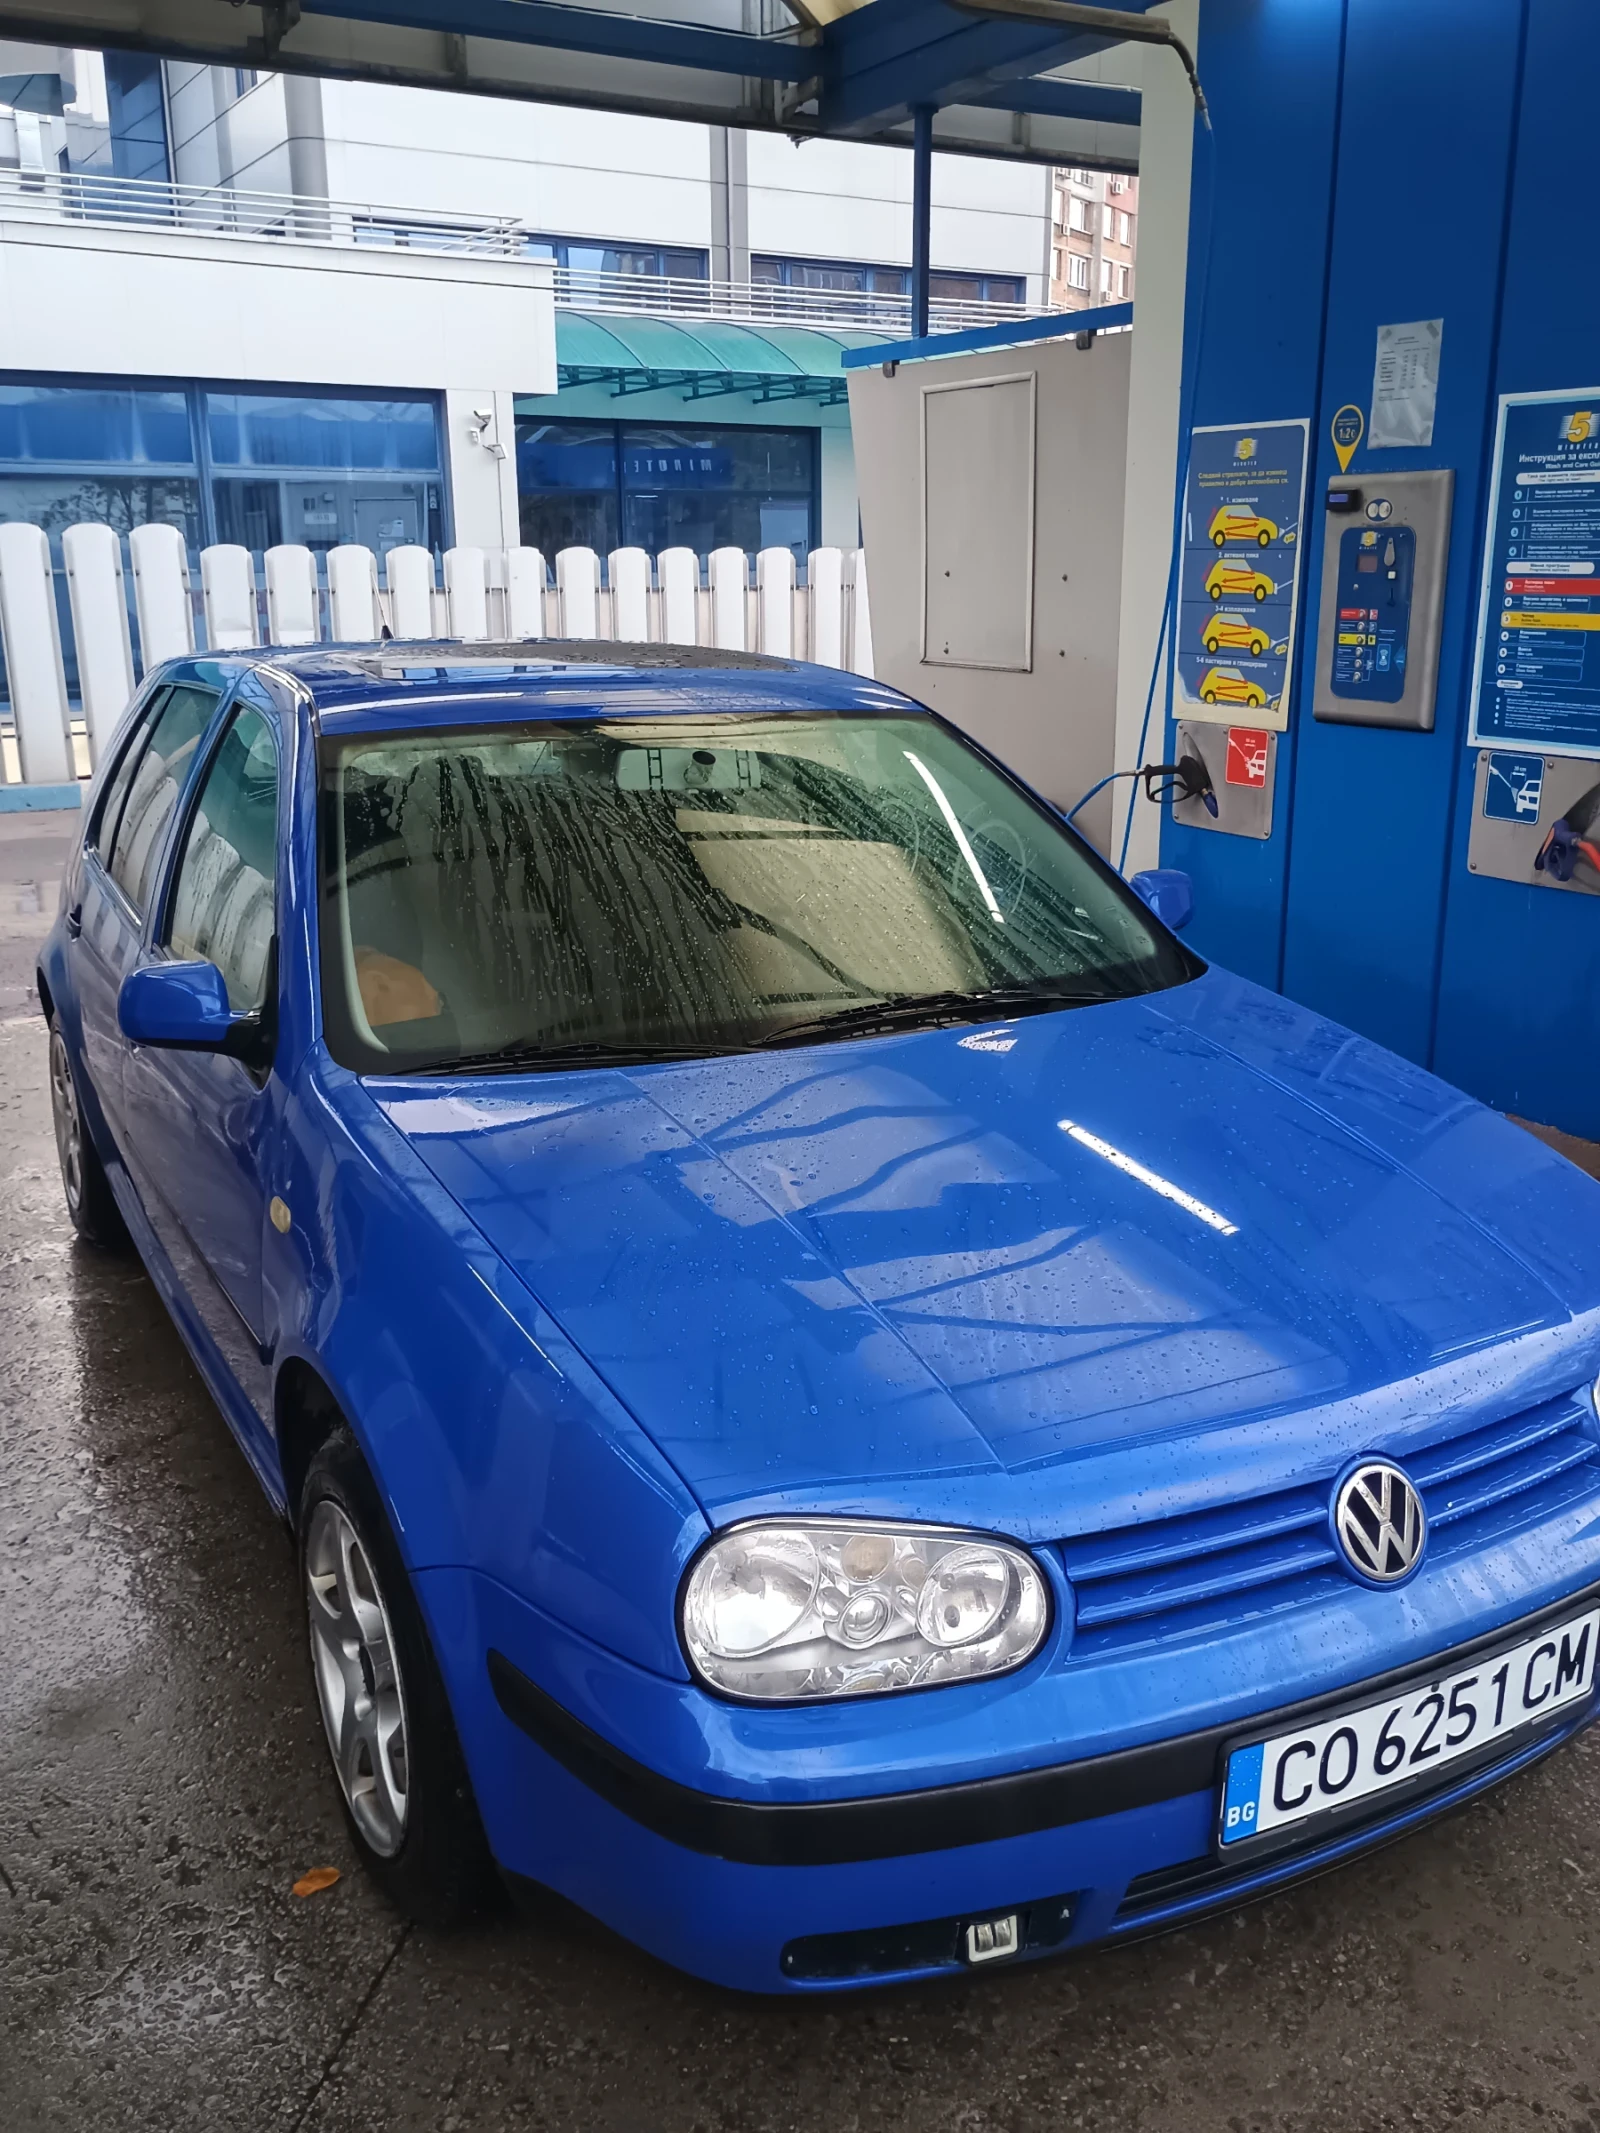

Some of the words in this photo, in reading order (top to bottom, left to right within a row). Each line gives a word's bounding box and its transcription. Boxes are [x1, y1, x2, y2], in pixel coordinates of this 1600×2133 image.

[1567, 411, 1591, 442] 5
[1519, 454, 1565, 463] Инструкция
[1273, 1726, 1358, 1811] CO
[1373, 1662, 1510, 1776] 6251
[1522, 1623, 1591, 1709] CM
[1226, 1801, 1256, 1828] BG
